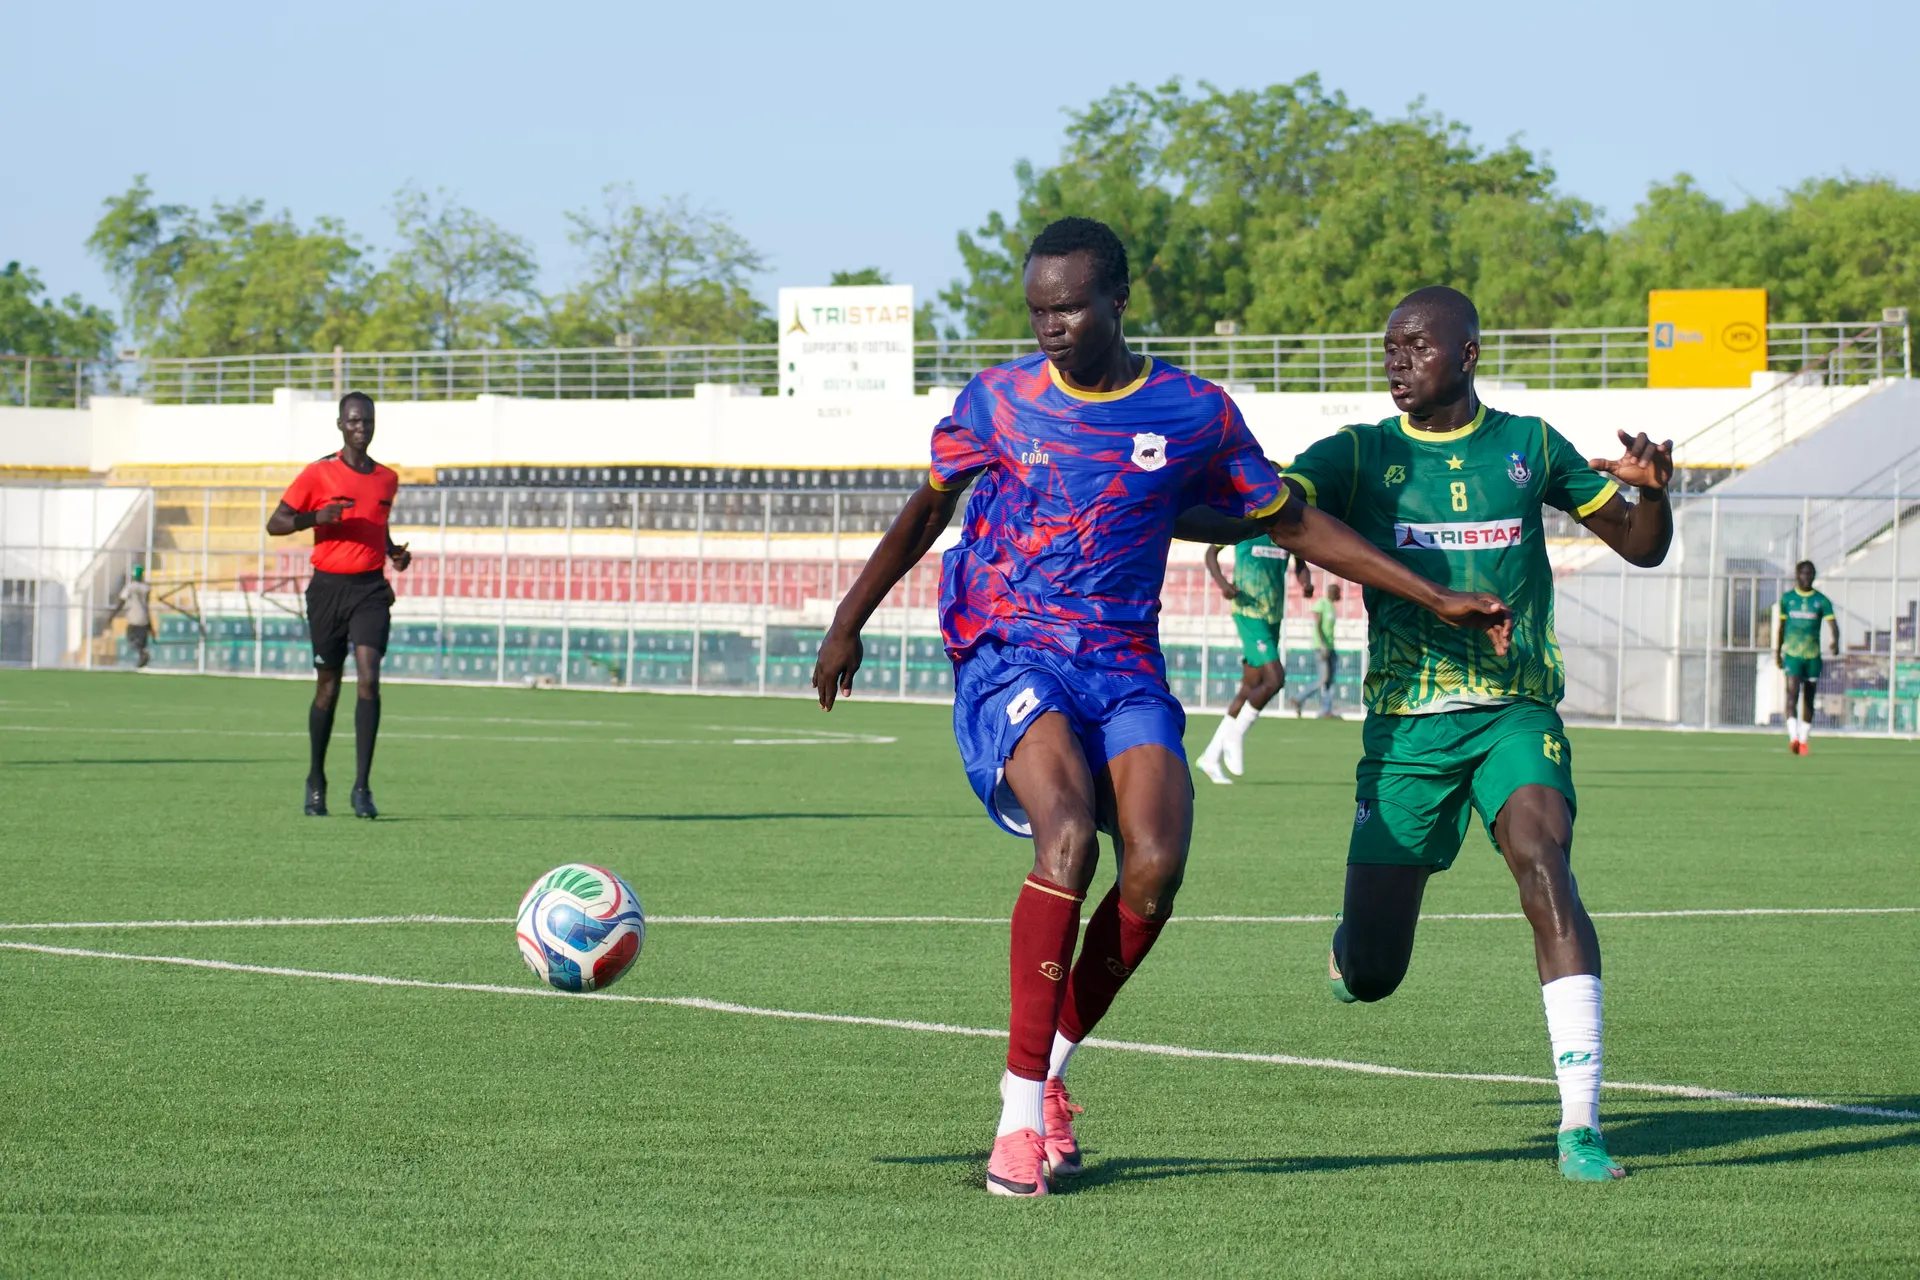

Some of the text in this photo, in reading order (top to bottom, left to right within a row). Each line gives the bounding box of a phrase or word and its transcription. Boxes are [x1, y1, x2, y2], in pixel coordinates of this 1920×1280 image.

[812, 306, 910, 325] TRISTAR
[1021, 452, 1049, 465] COPA
[1449, 481, 1468, 512] 8
[1424, 526, 1520, 544] TRISTAR
